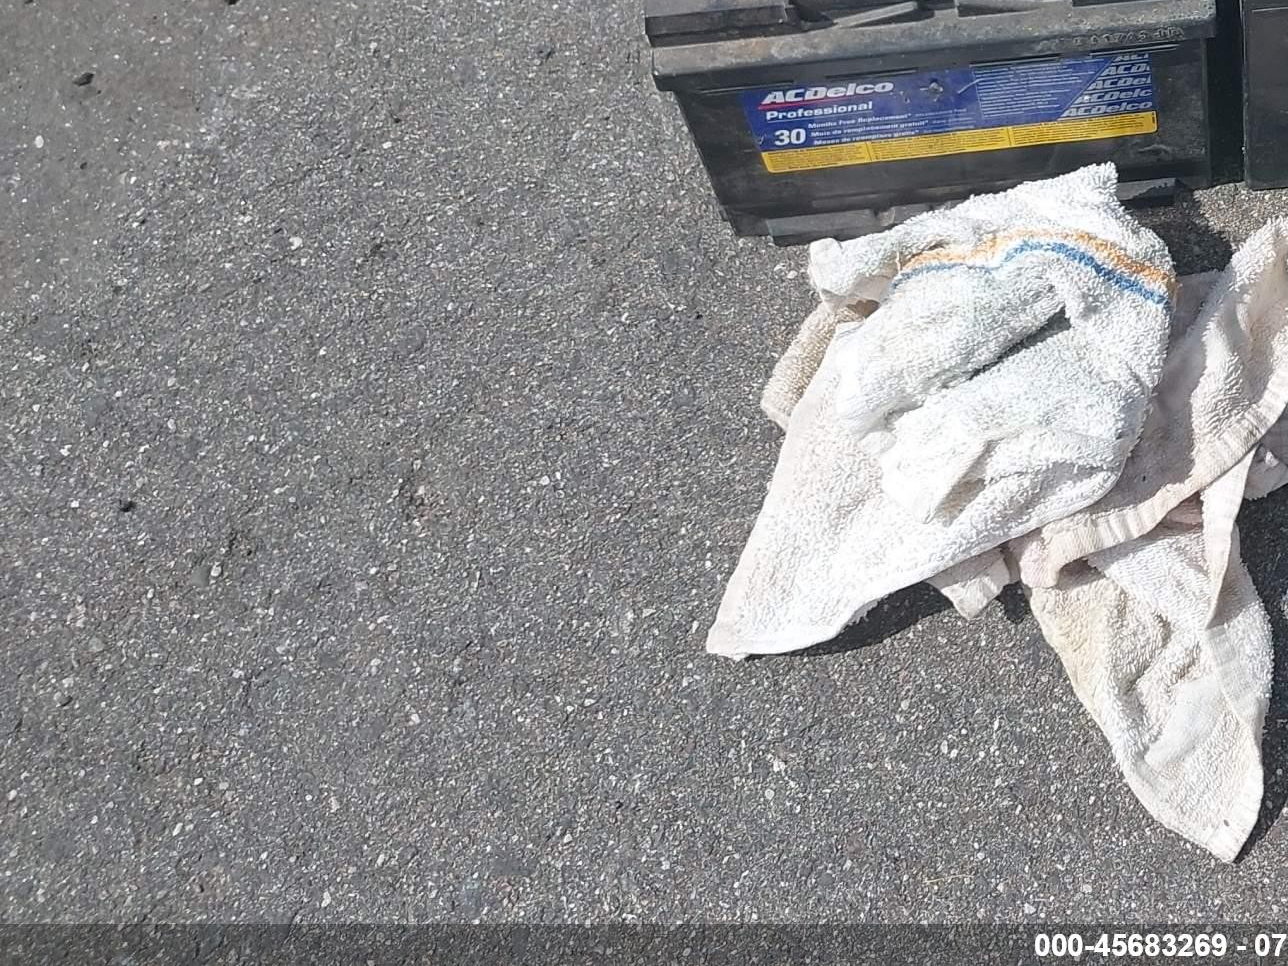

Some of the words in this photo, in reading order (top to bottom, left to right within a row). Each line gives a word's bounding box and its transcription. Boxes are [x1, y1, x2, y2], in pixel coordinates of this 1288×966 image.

[761, 81, 894, 105] ACDelco
[766, 101, 873, 121] Professional
[1061, 101, 1152, 117] ACDelco
[774, 129, 806, 146] 30
